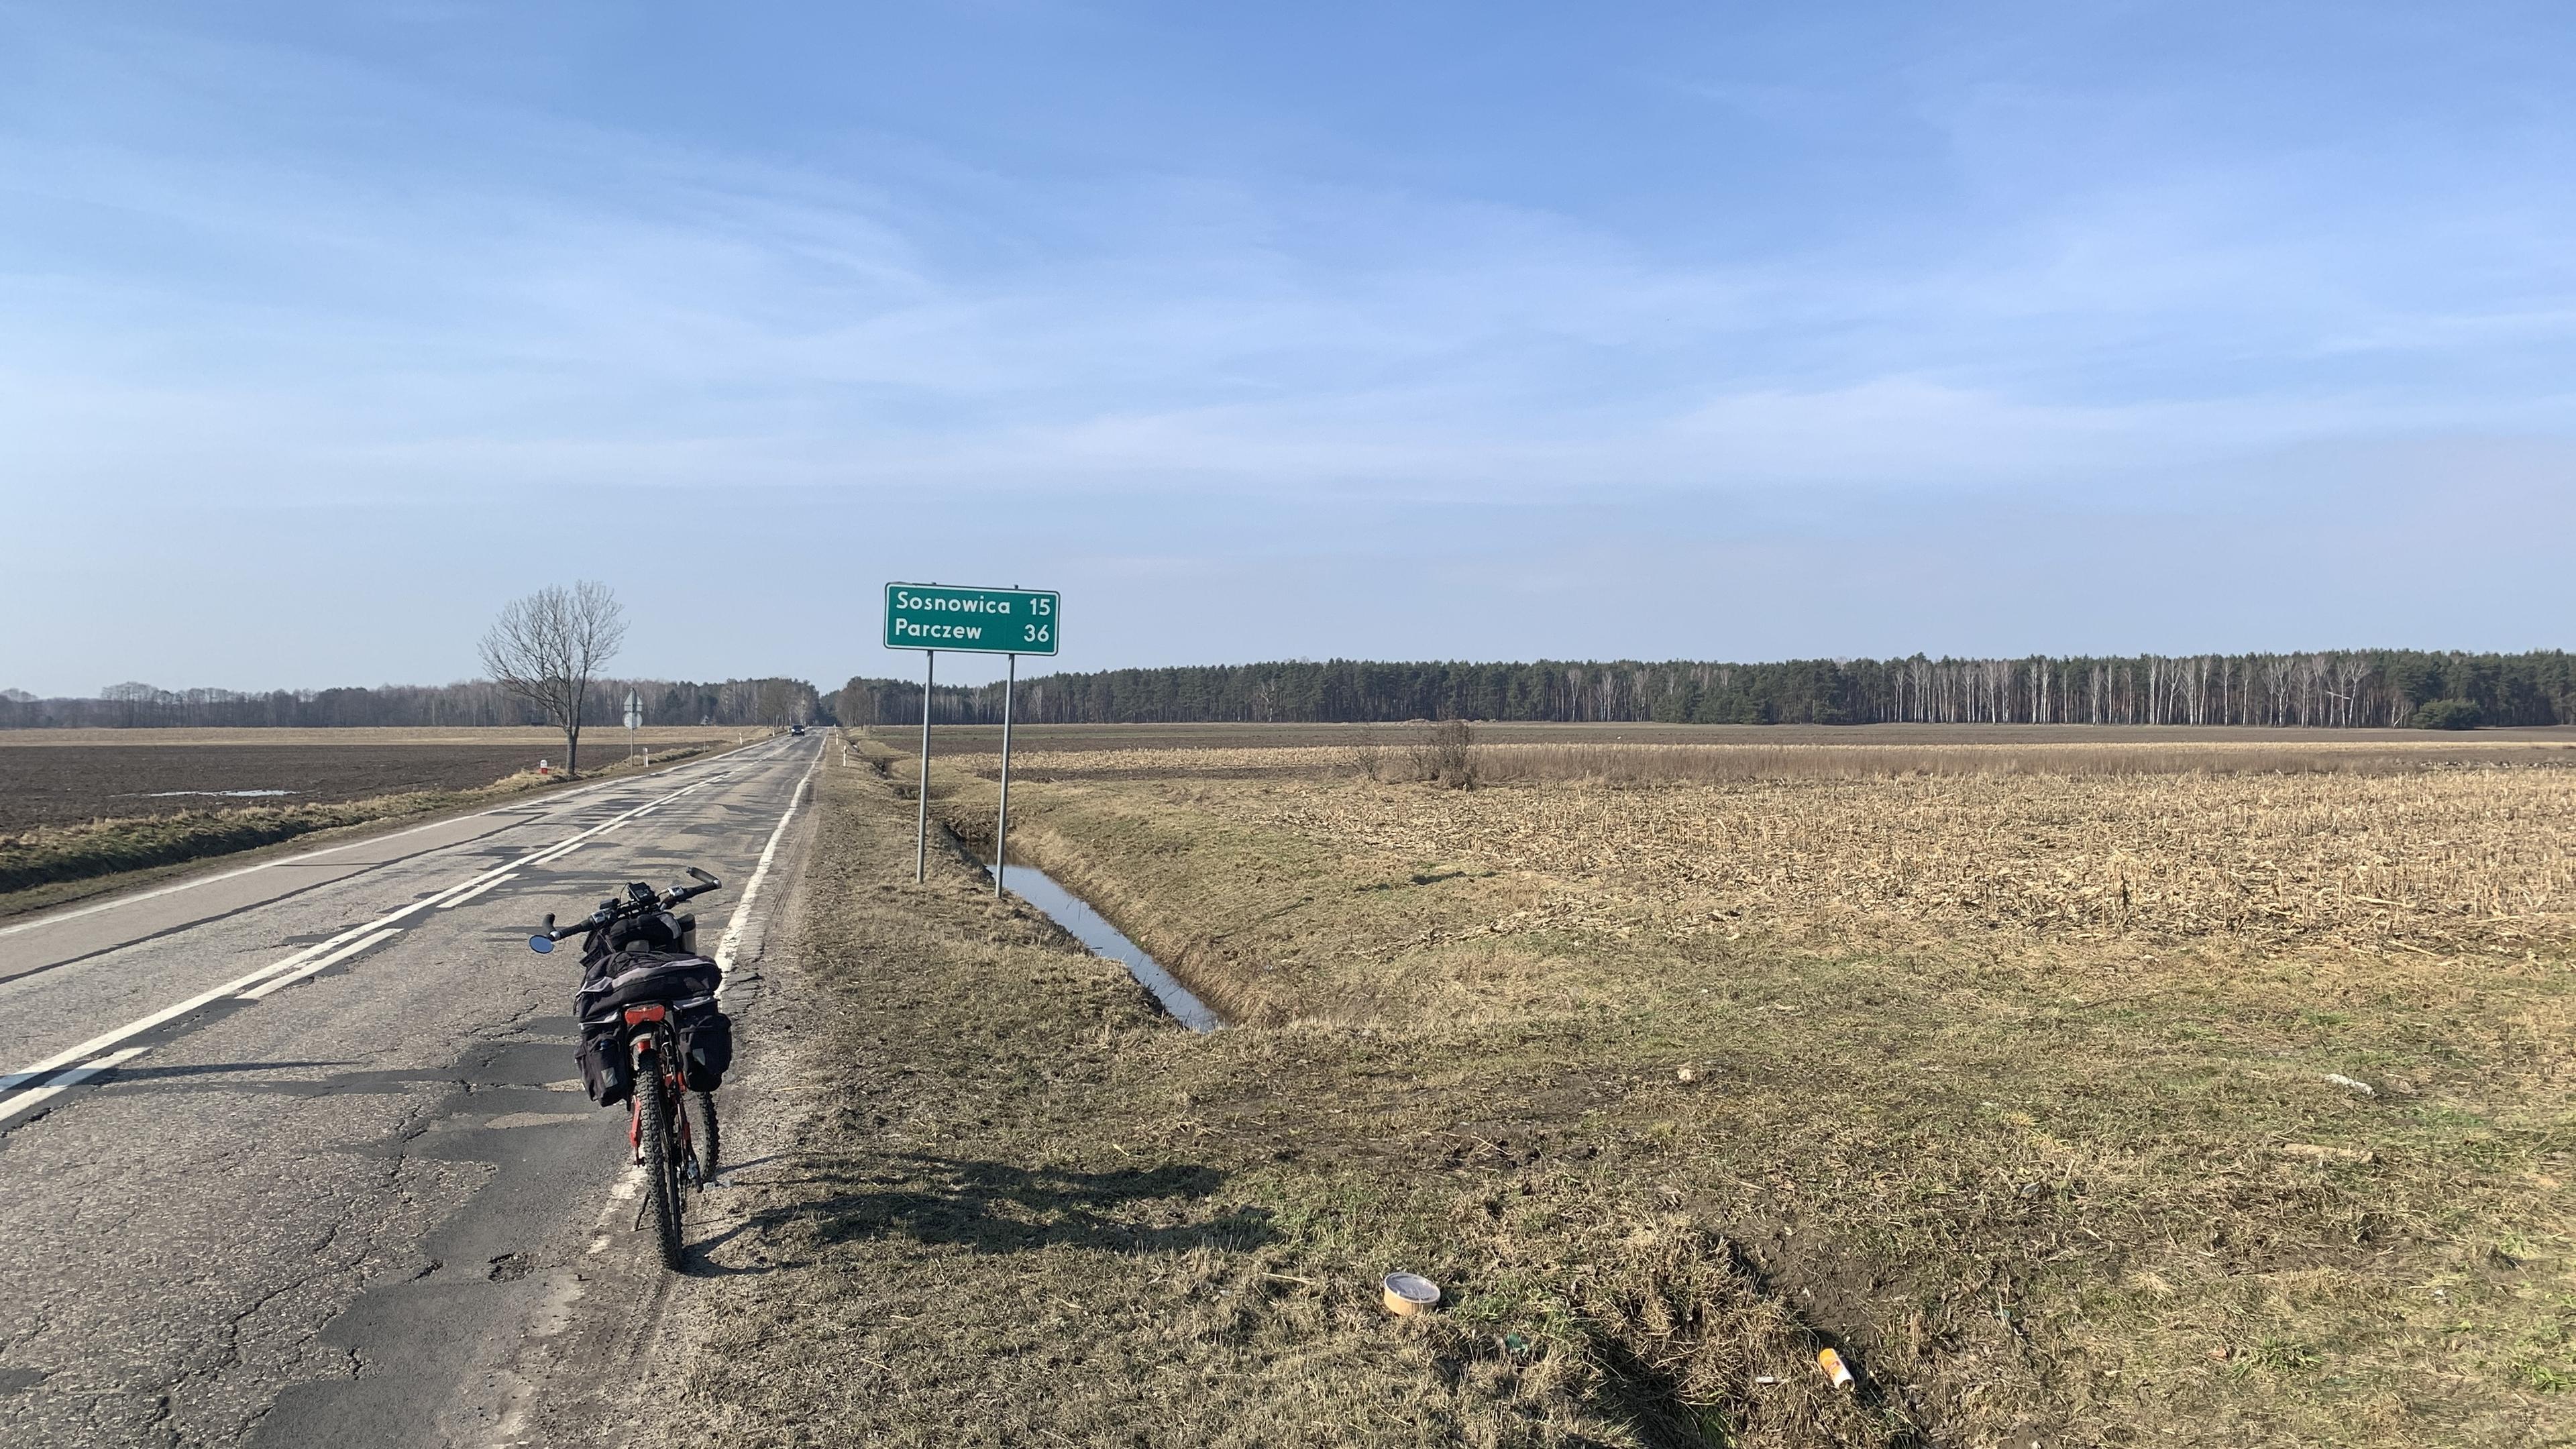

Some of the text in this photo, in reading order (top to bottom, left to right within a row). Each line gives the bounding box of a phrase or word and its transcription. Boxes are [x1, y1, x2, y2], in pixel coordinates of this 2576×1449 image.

[896, 591, 1051, 616] Sosnowica 15
[896, 618, 1049, 642] Parczew 36
